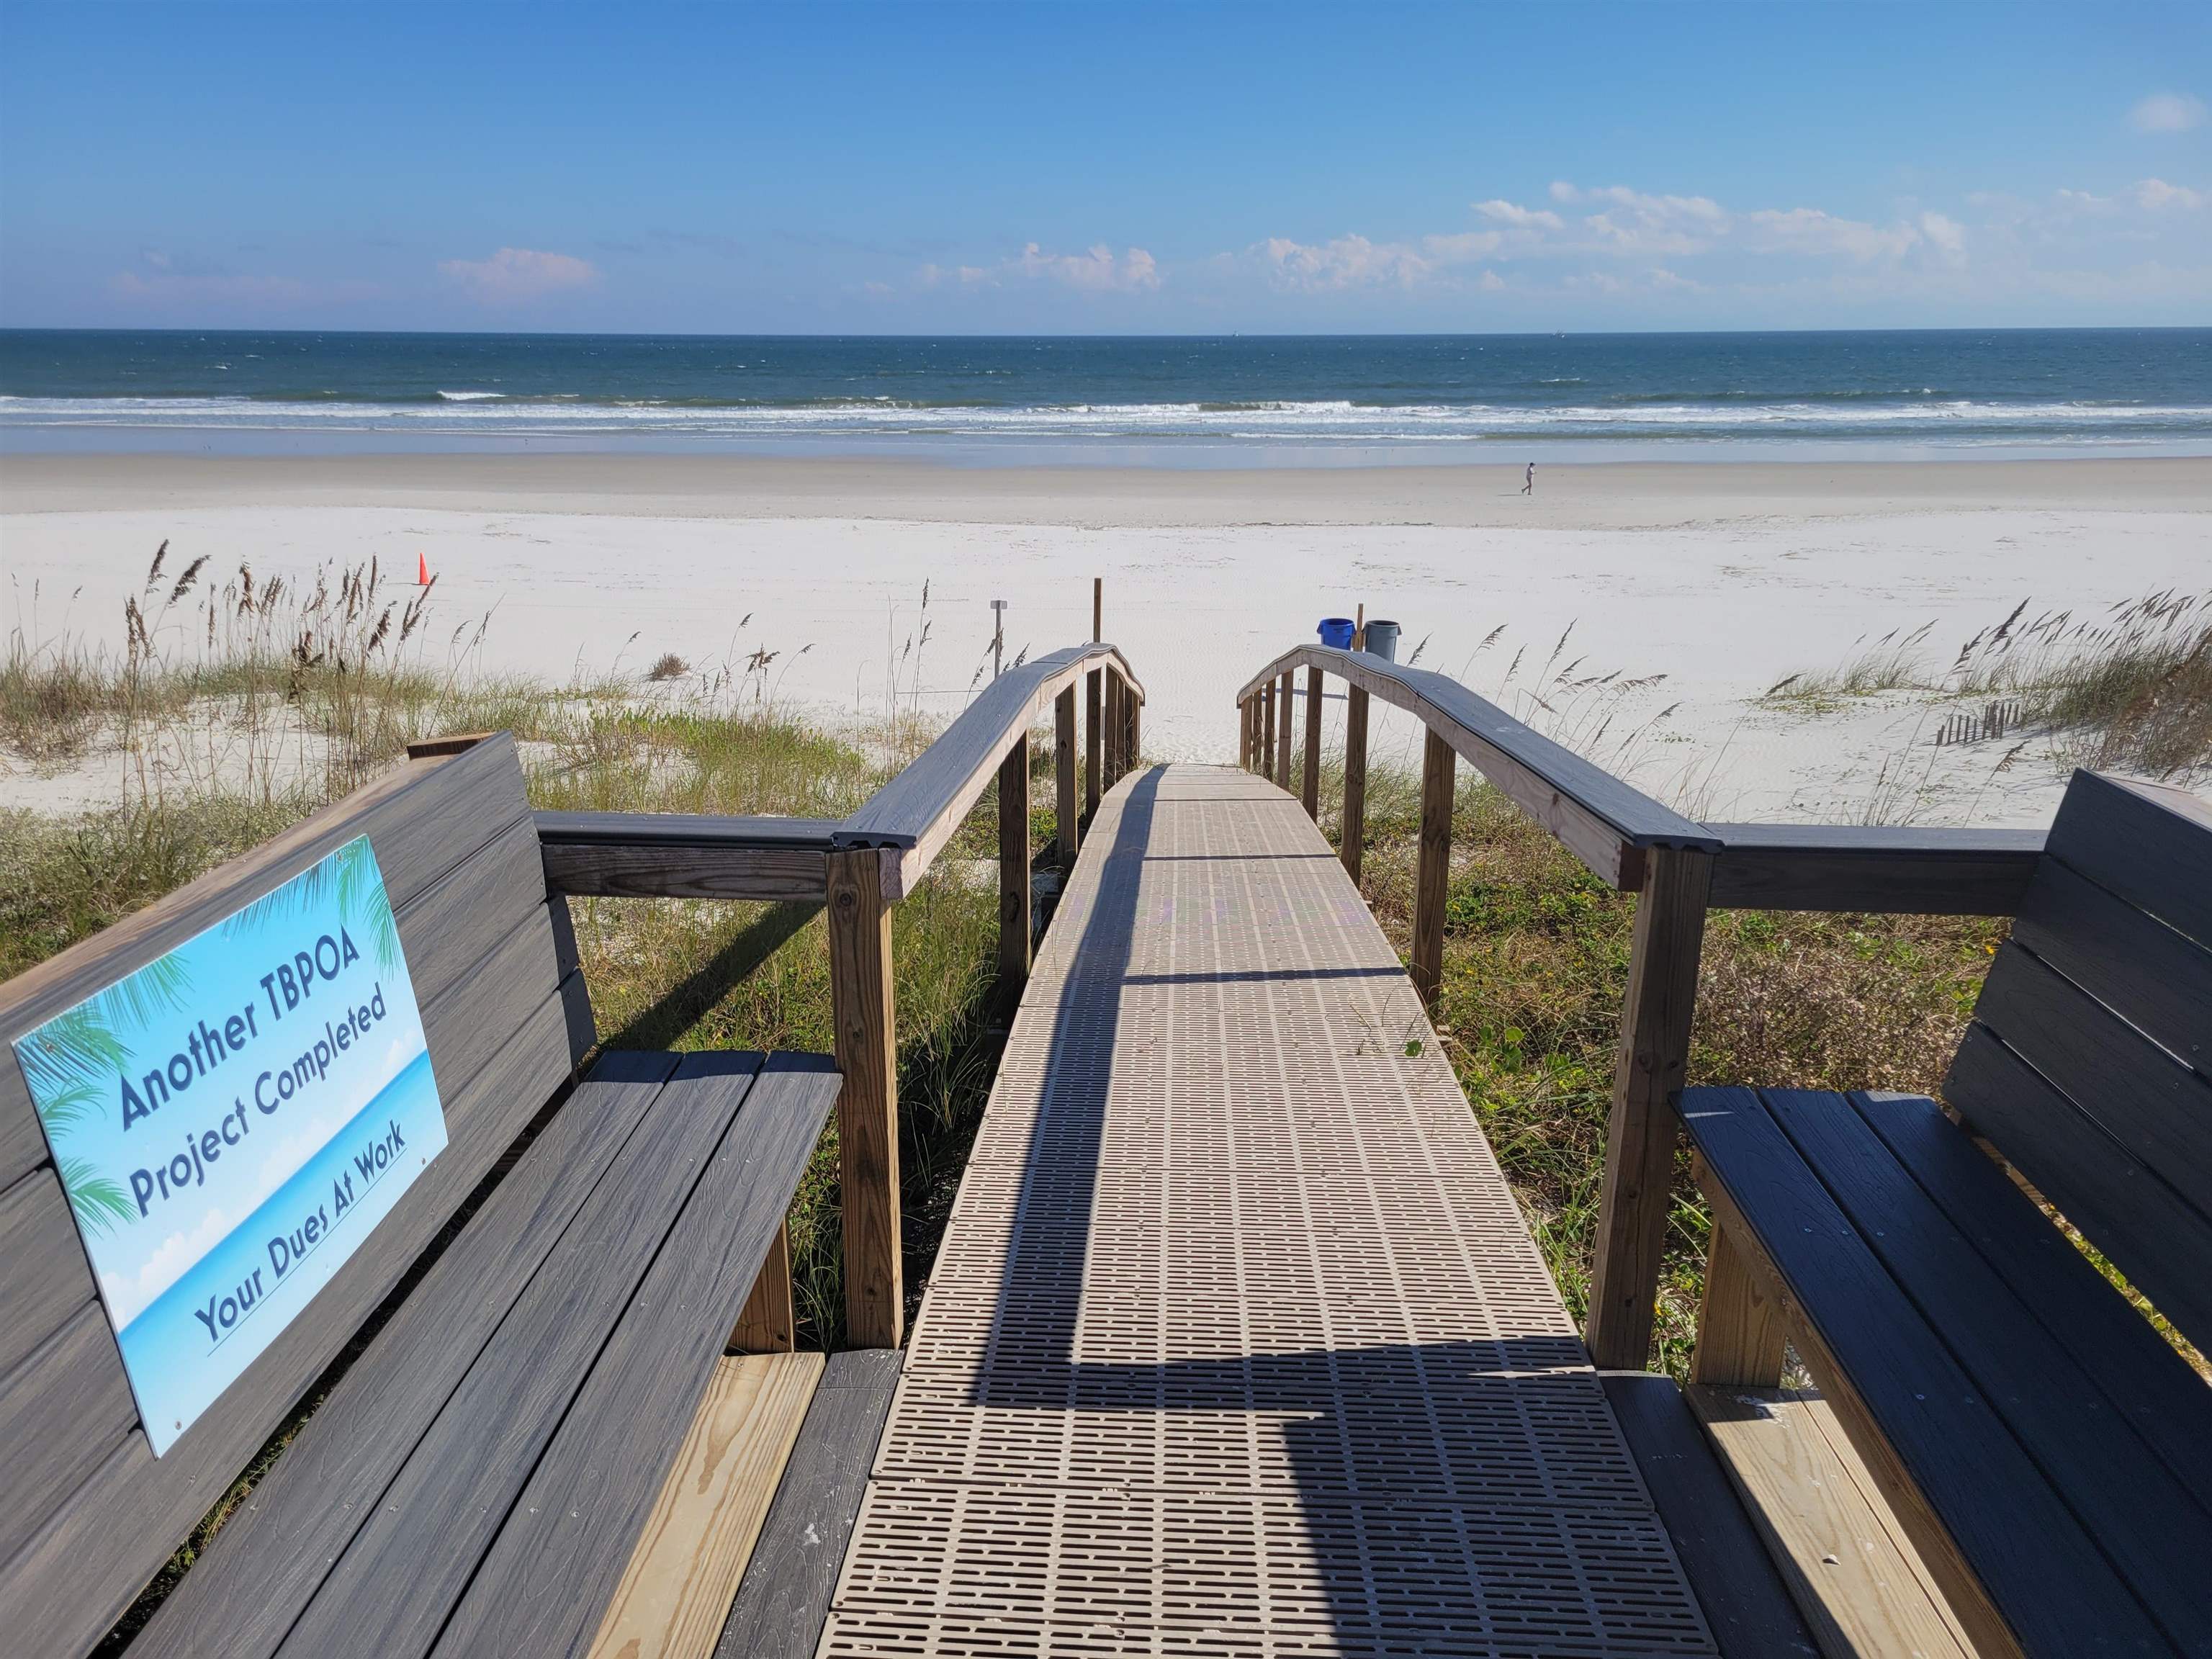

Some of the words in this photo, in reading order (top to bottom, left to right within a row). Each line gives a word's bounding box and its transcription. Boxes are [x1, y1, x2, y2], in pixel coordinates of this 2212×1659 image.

[121, 1002, 258, 1132] Another
[260, 925, 359, 1021] TBPOA
[130, 1097, 250, 1218] Project
[255, 981, 387, 1114] Completed
[194, 1267, 264, 1342] Your
[268, 1204, 328, 1279] Dues
[333, 1170, 354, 1218] At
[354, 1120, 405, 1184] Work
